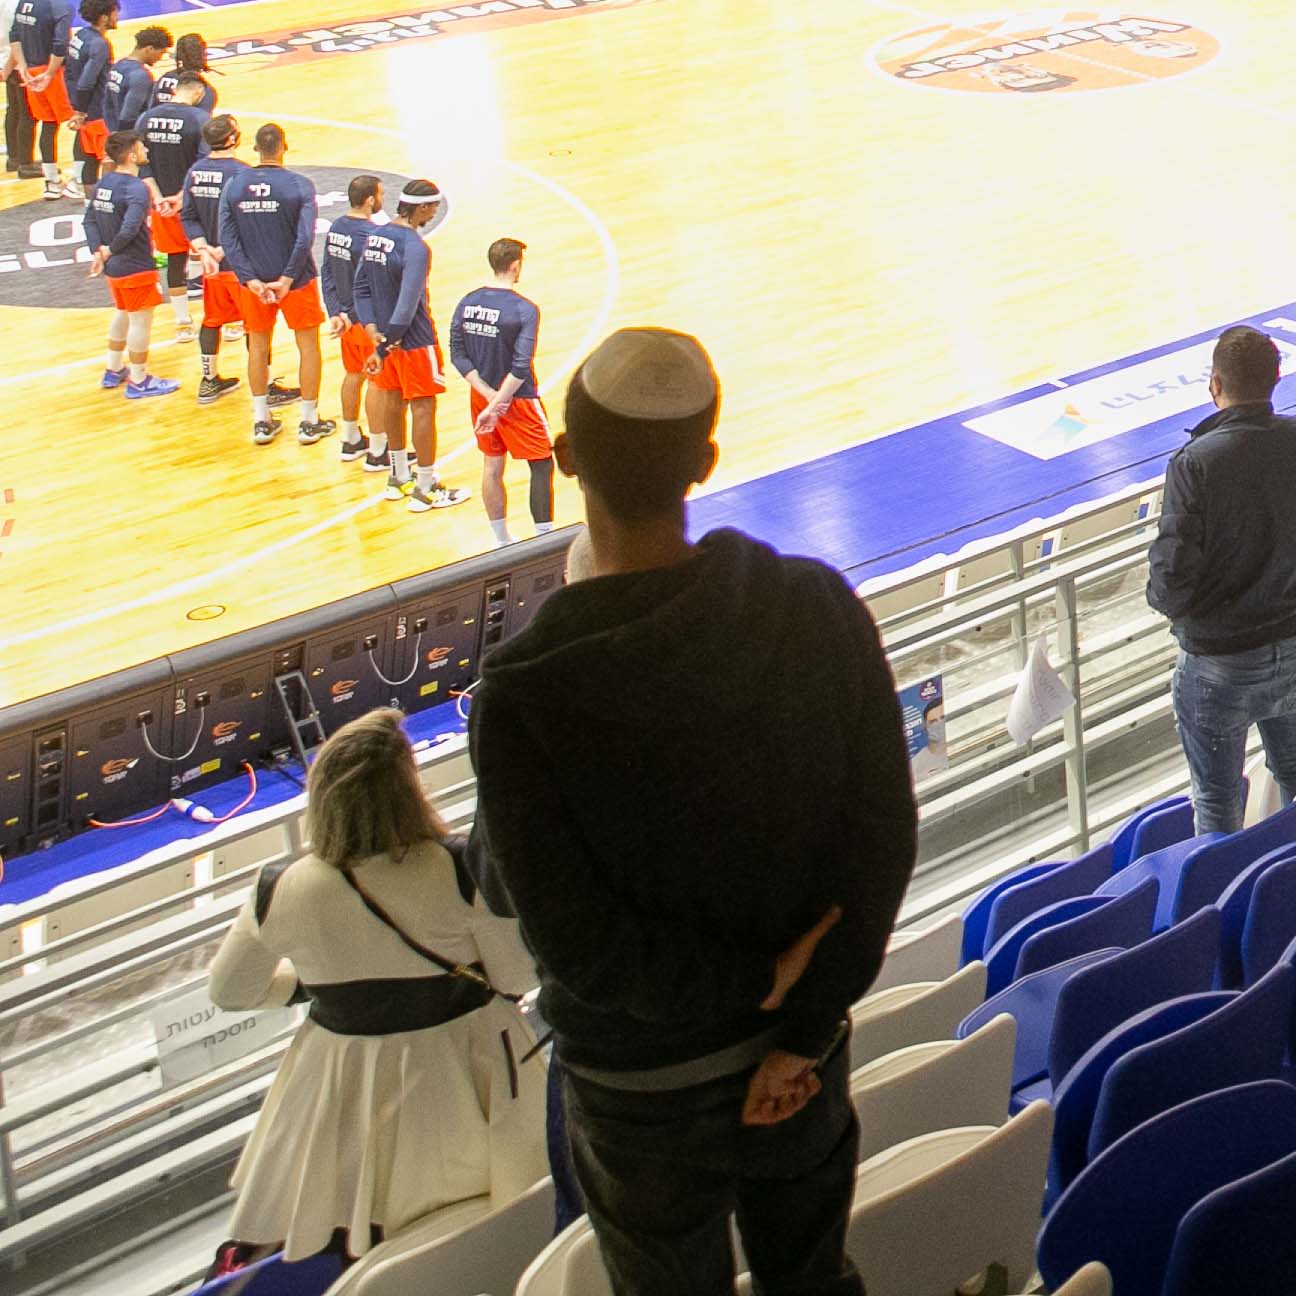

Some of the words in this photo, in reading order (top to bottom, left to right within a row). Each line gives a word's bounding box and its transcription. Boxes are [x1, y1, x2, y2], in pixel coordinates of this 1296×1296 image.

[896, 17, 1192, 80] Winner
[248, 182, 271, 197] לוי
[201, 1016, 257, 1049] מסכה
